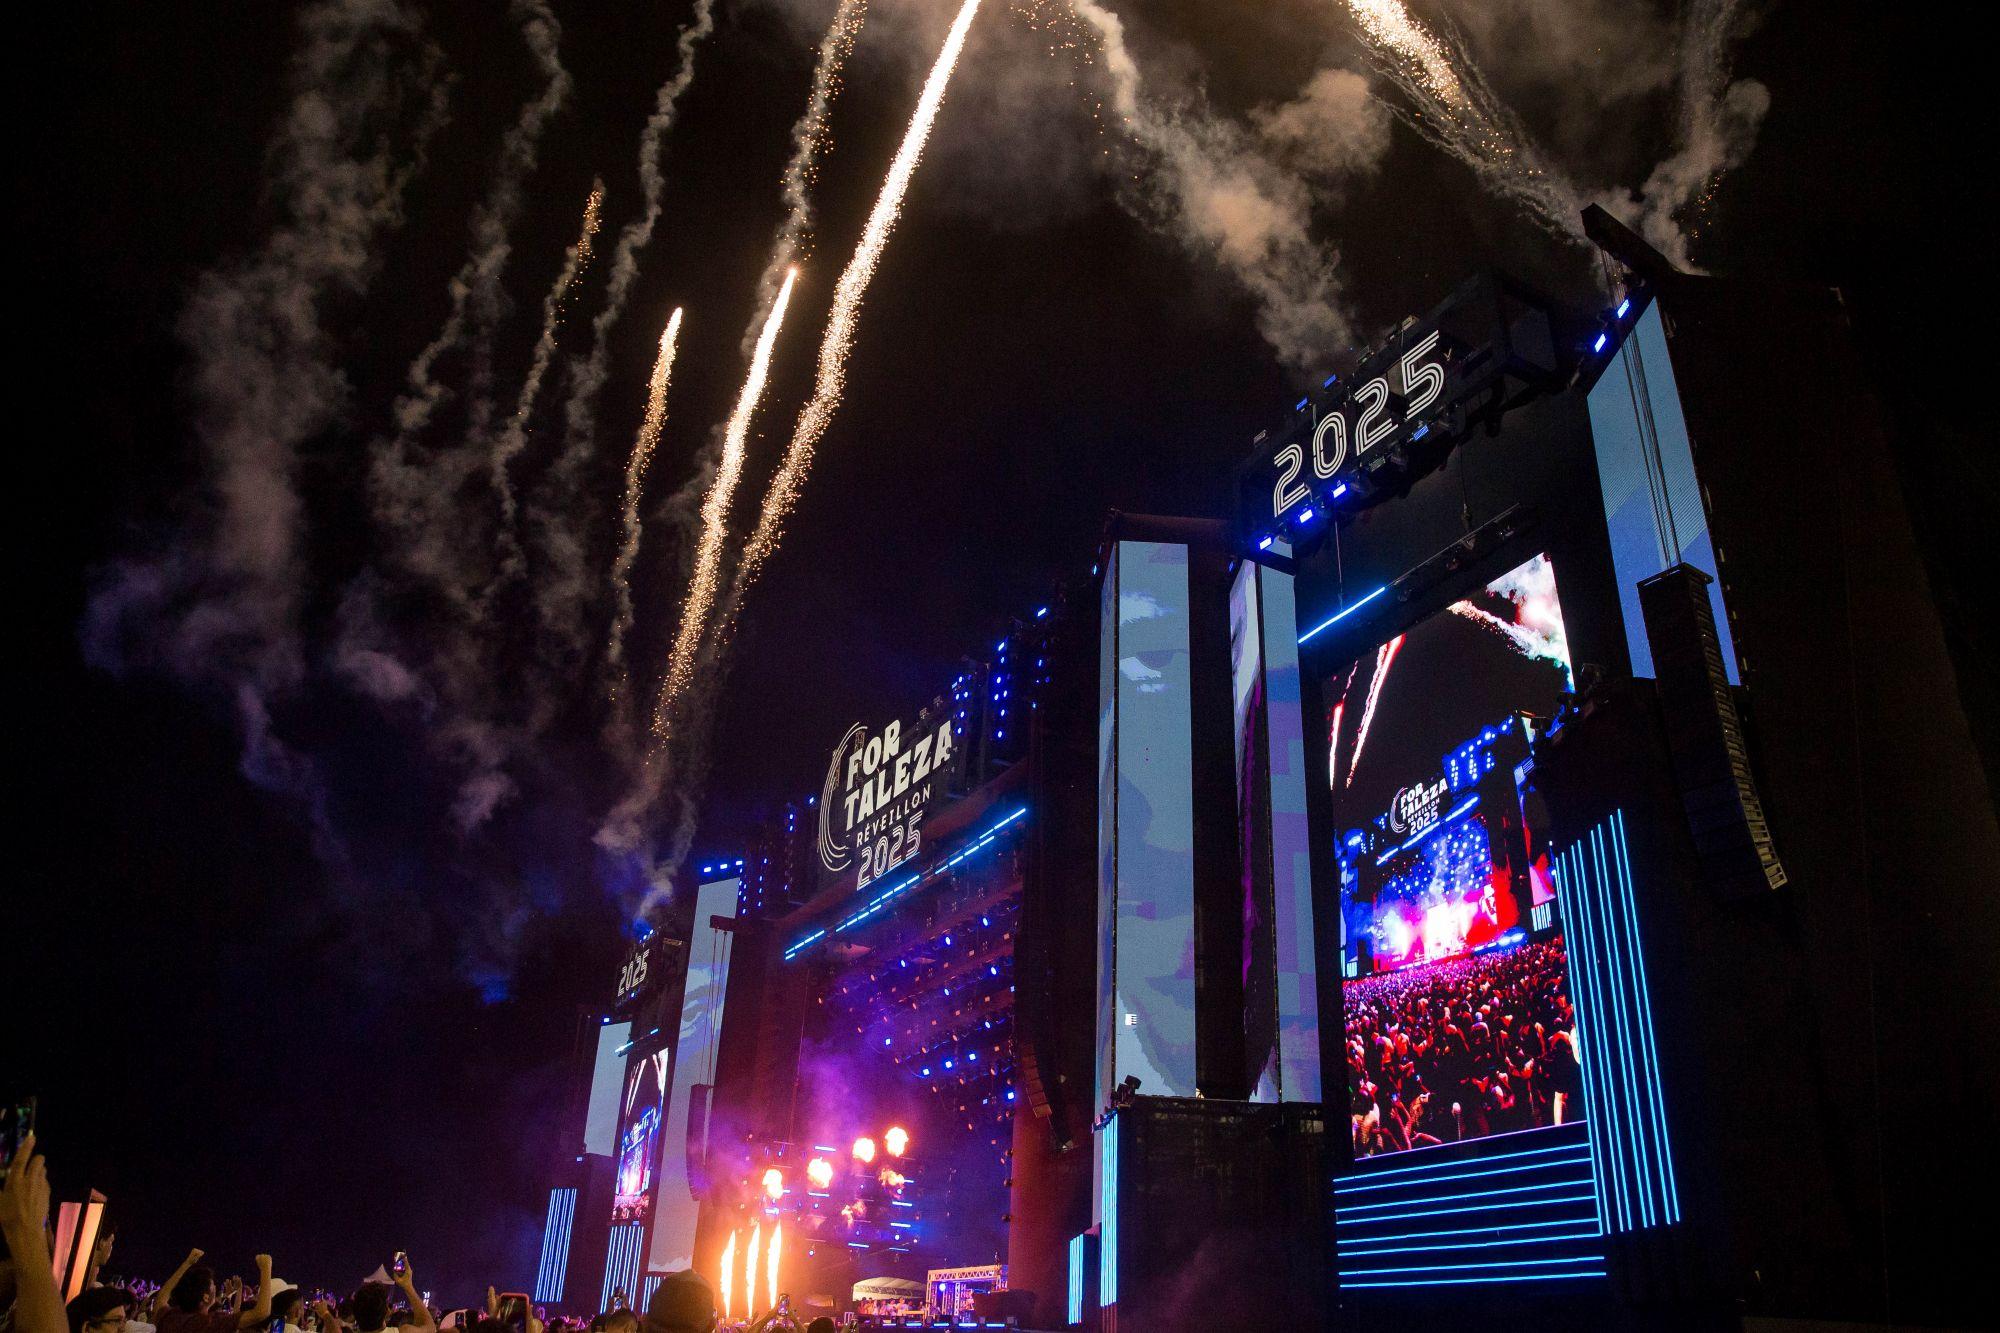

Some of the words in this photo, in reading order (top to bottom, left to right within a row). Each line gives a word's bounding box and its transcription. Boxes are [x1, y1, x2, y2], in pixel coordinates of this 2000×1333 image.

[1274, 330, 1444, 517] 2025
[844, 720, 952, 831] TALEZA
[846, 719, 900, 791] FOR
[1400, 783, 1423, 809] FOR
[1401, 778, 1448, 820] TALEZA
[1410, 806, 1438, 835] 2025
[857, 810, 923, 891] 2025
[618, 949, 648, 996] 2025
